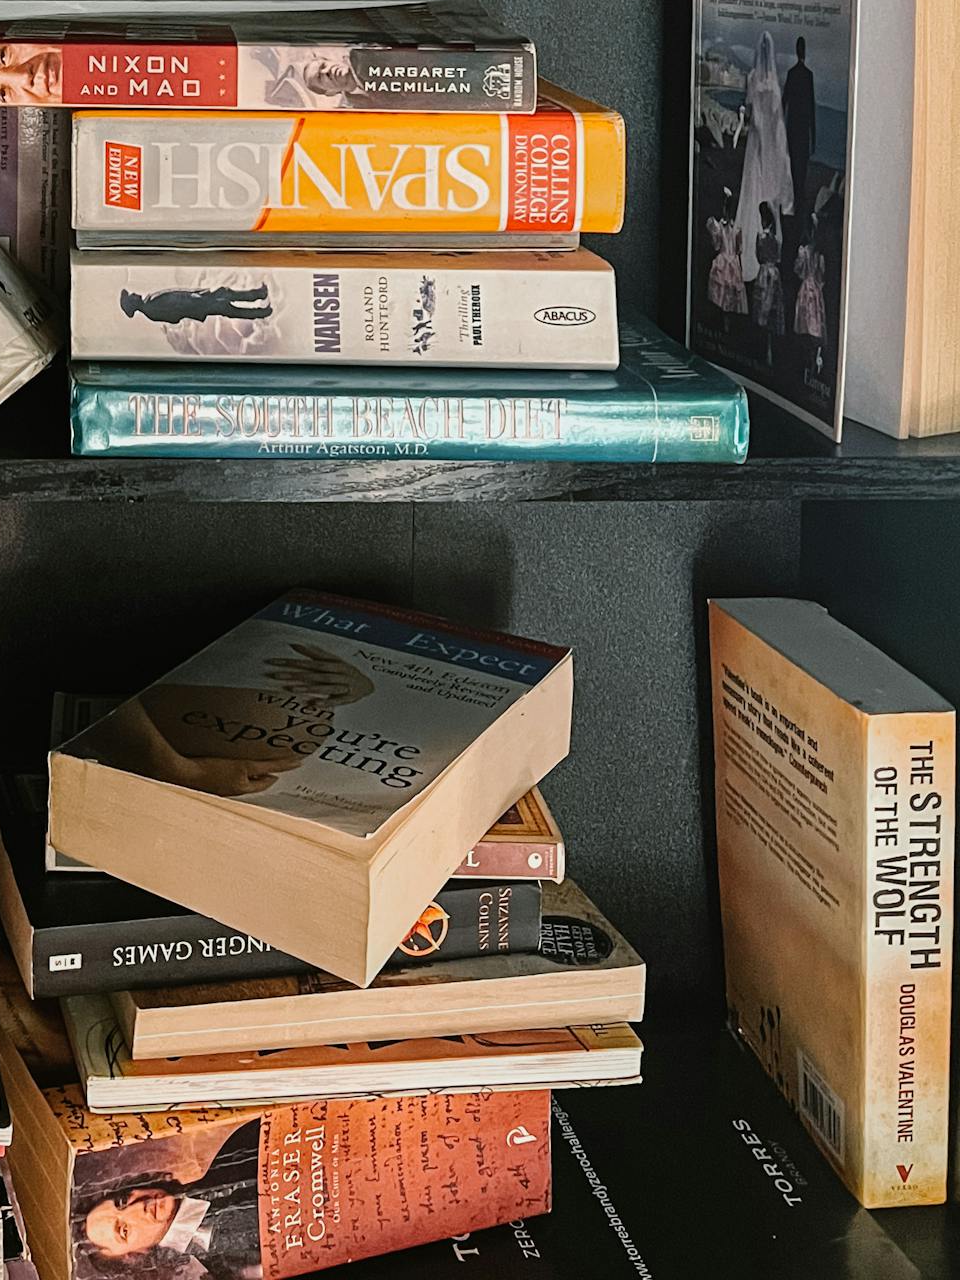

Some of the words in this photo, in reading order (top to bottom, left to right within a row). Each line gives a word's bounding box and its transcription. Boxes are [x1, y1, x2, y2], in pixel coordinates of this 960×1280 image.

[87, 54, 190, 74] NIXON
[363, 79, 471, 94] MACMILLAN
[368, 65, 467, 80] MARGARET
[513, 56, 524, 78] HOUSE
[81, 82, 119, 97] AND
[128, 77, 201, 98] MAO
[108, 147, 122, 203] EDITION
[124, 156, 139, 199] NEW
[152, 140, 492, 211] SPANISH
[513, 134, 528, 223] DICTIONARY
[529, 133, 548, 224] COLLEGE
[550, 133, 570, 223] COLLINS
[313, 273, 340, 353] NANSEN
[363, 285, 374, 343] ROLAND
[378, 275, 389, 352] HUNTFORD
[472, 284, 481, 325] THEROUX
[543, 308, 588, 323] ABACUS
[472, 326, 481, 347] PAUL
[129, 395, 203, 437] THE
[216, 395, 333, 437] SOUTH
[352, 397, 467, 438] BEACH
[484, 398, 568, 438] DIET
[258, 441, 314, 455] Arthur
[395, 443, 430, 455] M.D.
[281, 603, 371, 636] What
[405, 631, 537, 677] Expect
[352, 650, 392, 668] New
[401, 661, 434, 677] 4th
[441, 671, 511, 695] Edition
[406, 682, 434, 695] and
[435, 687, 497, 709] Updated
[447, 682, 504, 702] Revised
[257, 692, 335, 721] when
[181, 708, 424, 789] expecting
[909, 739, 935, 785] THE
[874, 766, 898, 797] OF
[875, 802, 898, 847] THE
[875, 856, 905, 946] WOLF
[909, 792, 942, 969] STRENGTH
[479, 892, 493, 950] COLLINS
[497, 886, 513, 948] SUZANNE
[540, 923, 553, 954] PRICE
[554, 924, 574, 956] HALF
[113, 941, 193, 967] GAMES
[899, 983, 916, 1061] DOUGLAS
[897, 1064, 915, 1142] VALENTINE
[306, 1125, 327, 1241] Cromwell
[732, 1118, 803, 1208] TORRES
[269, 1148, 282, 1233] ANTONIA
[285, 1128, 303, 1249] FRASER
